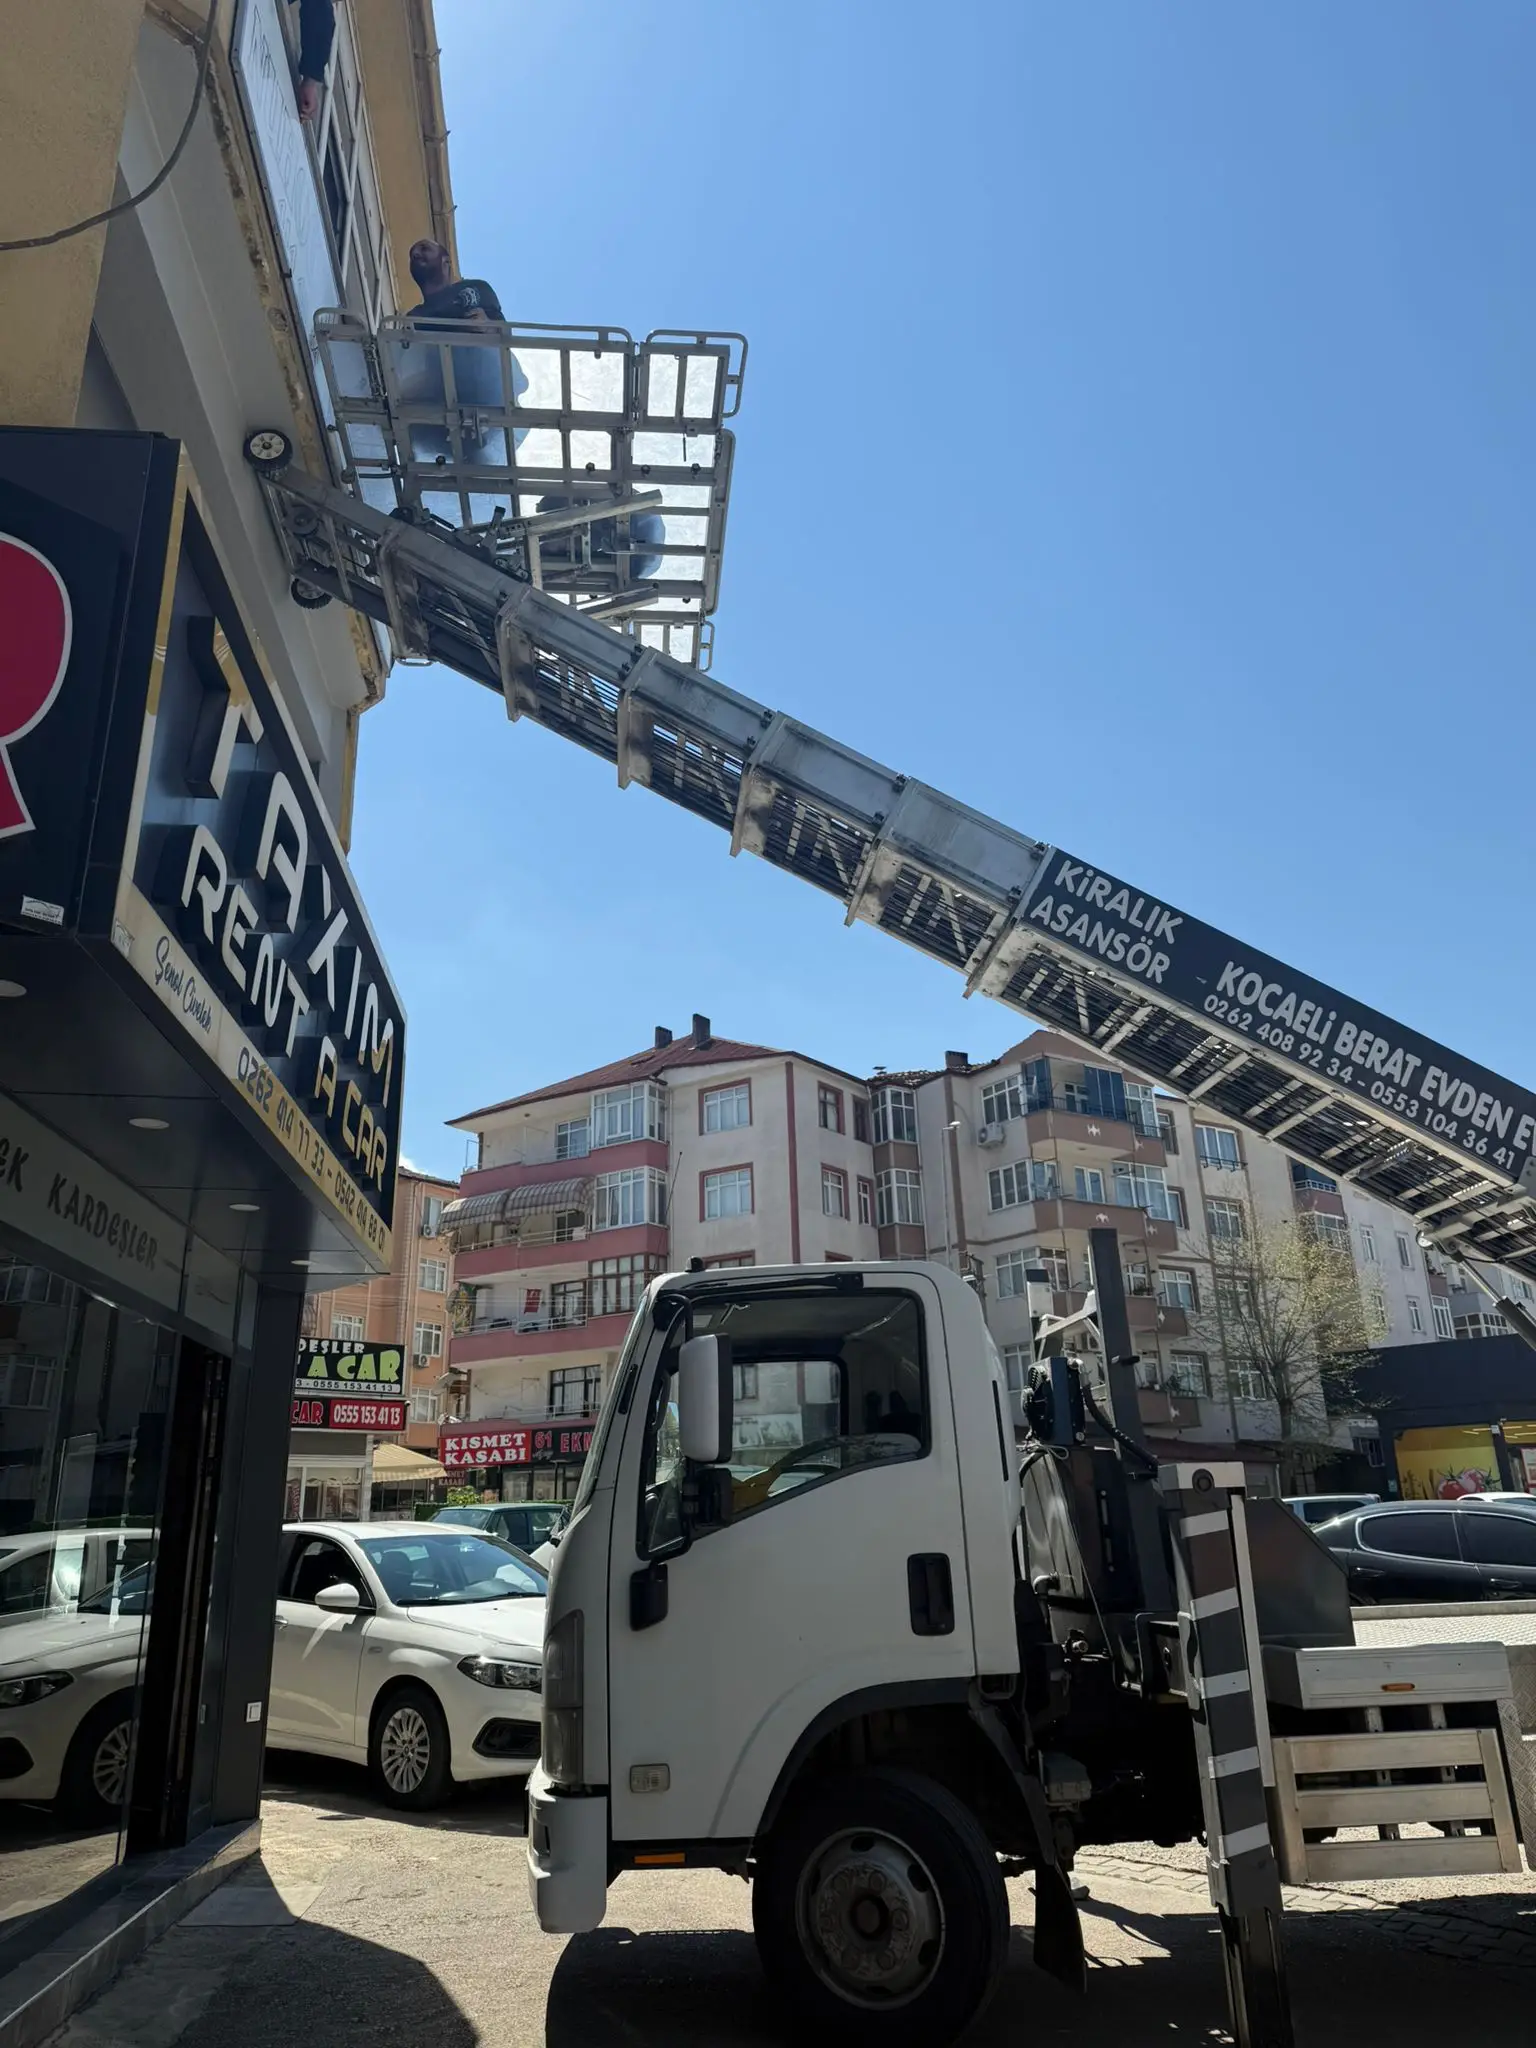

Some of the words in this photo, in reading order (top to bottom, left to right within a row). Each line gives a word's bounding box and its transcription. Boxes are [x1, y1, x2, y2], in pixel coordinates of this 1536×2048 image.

[1030, 895, 1171, 984] ASANSÖR
[181, 824, 310, 1058] RENT
[314, 1035, 338, 1118] A
[342, 1079, 387, 1192] CAR
[1203, 993, 1249, 1032] 0262
[1256, 1023, 1295, 1053] 408
[1298, 1042, 1320, 1068] 92
[1326, 1057, 1353, 1085] 34
[1370, 1081, 1420, 1118] 0553
[1424, 1107, 1459, 1139] 104
[1462, 1129, 1488, 1157] 36
[1492, 1146, 1515, 1170] 41
[1333, 1020, 1422, 1088] BERAT
[1419, 1063, 1514, 1141] EVDEN
[237, 1046, 274, 1114] 0262
[276, 1098, 295, 1140] 414
[297, 1119, 310, 1161] 77
[310, 1140, 325, 1178] 33
[334, 1170, 356, 1215] 0542
[47, 1172, 158, 1271] KARDEŞLER
[307, 1355, 329, 1378] A
[336, 1349, 401, 1383] CAR
[313, 1378, 340, 1389] 0555
[343, 1382, 362, 1390] 153
[365, 1382, 377, 1391] 41
[381, 1383, 393, 1392] 13
[333, 1404, 359, 1424] 0555
[360, 1405, 376, 1424] 153
[378, 1406, 388, 1425] 41
[390, 1407, 401, 1425] 13
[444, 1433, 526, 1451] KISMET
[535, 1430, 553, 1449] 61
[444, 1448, 526, 1465] KASABI
